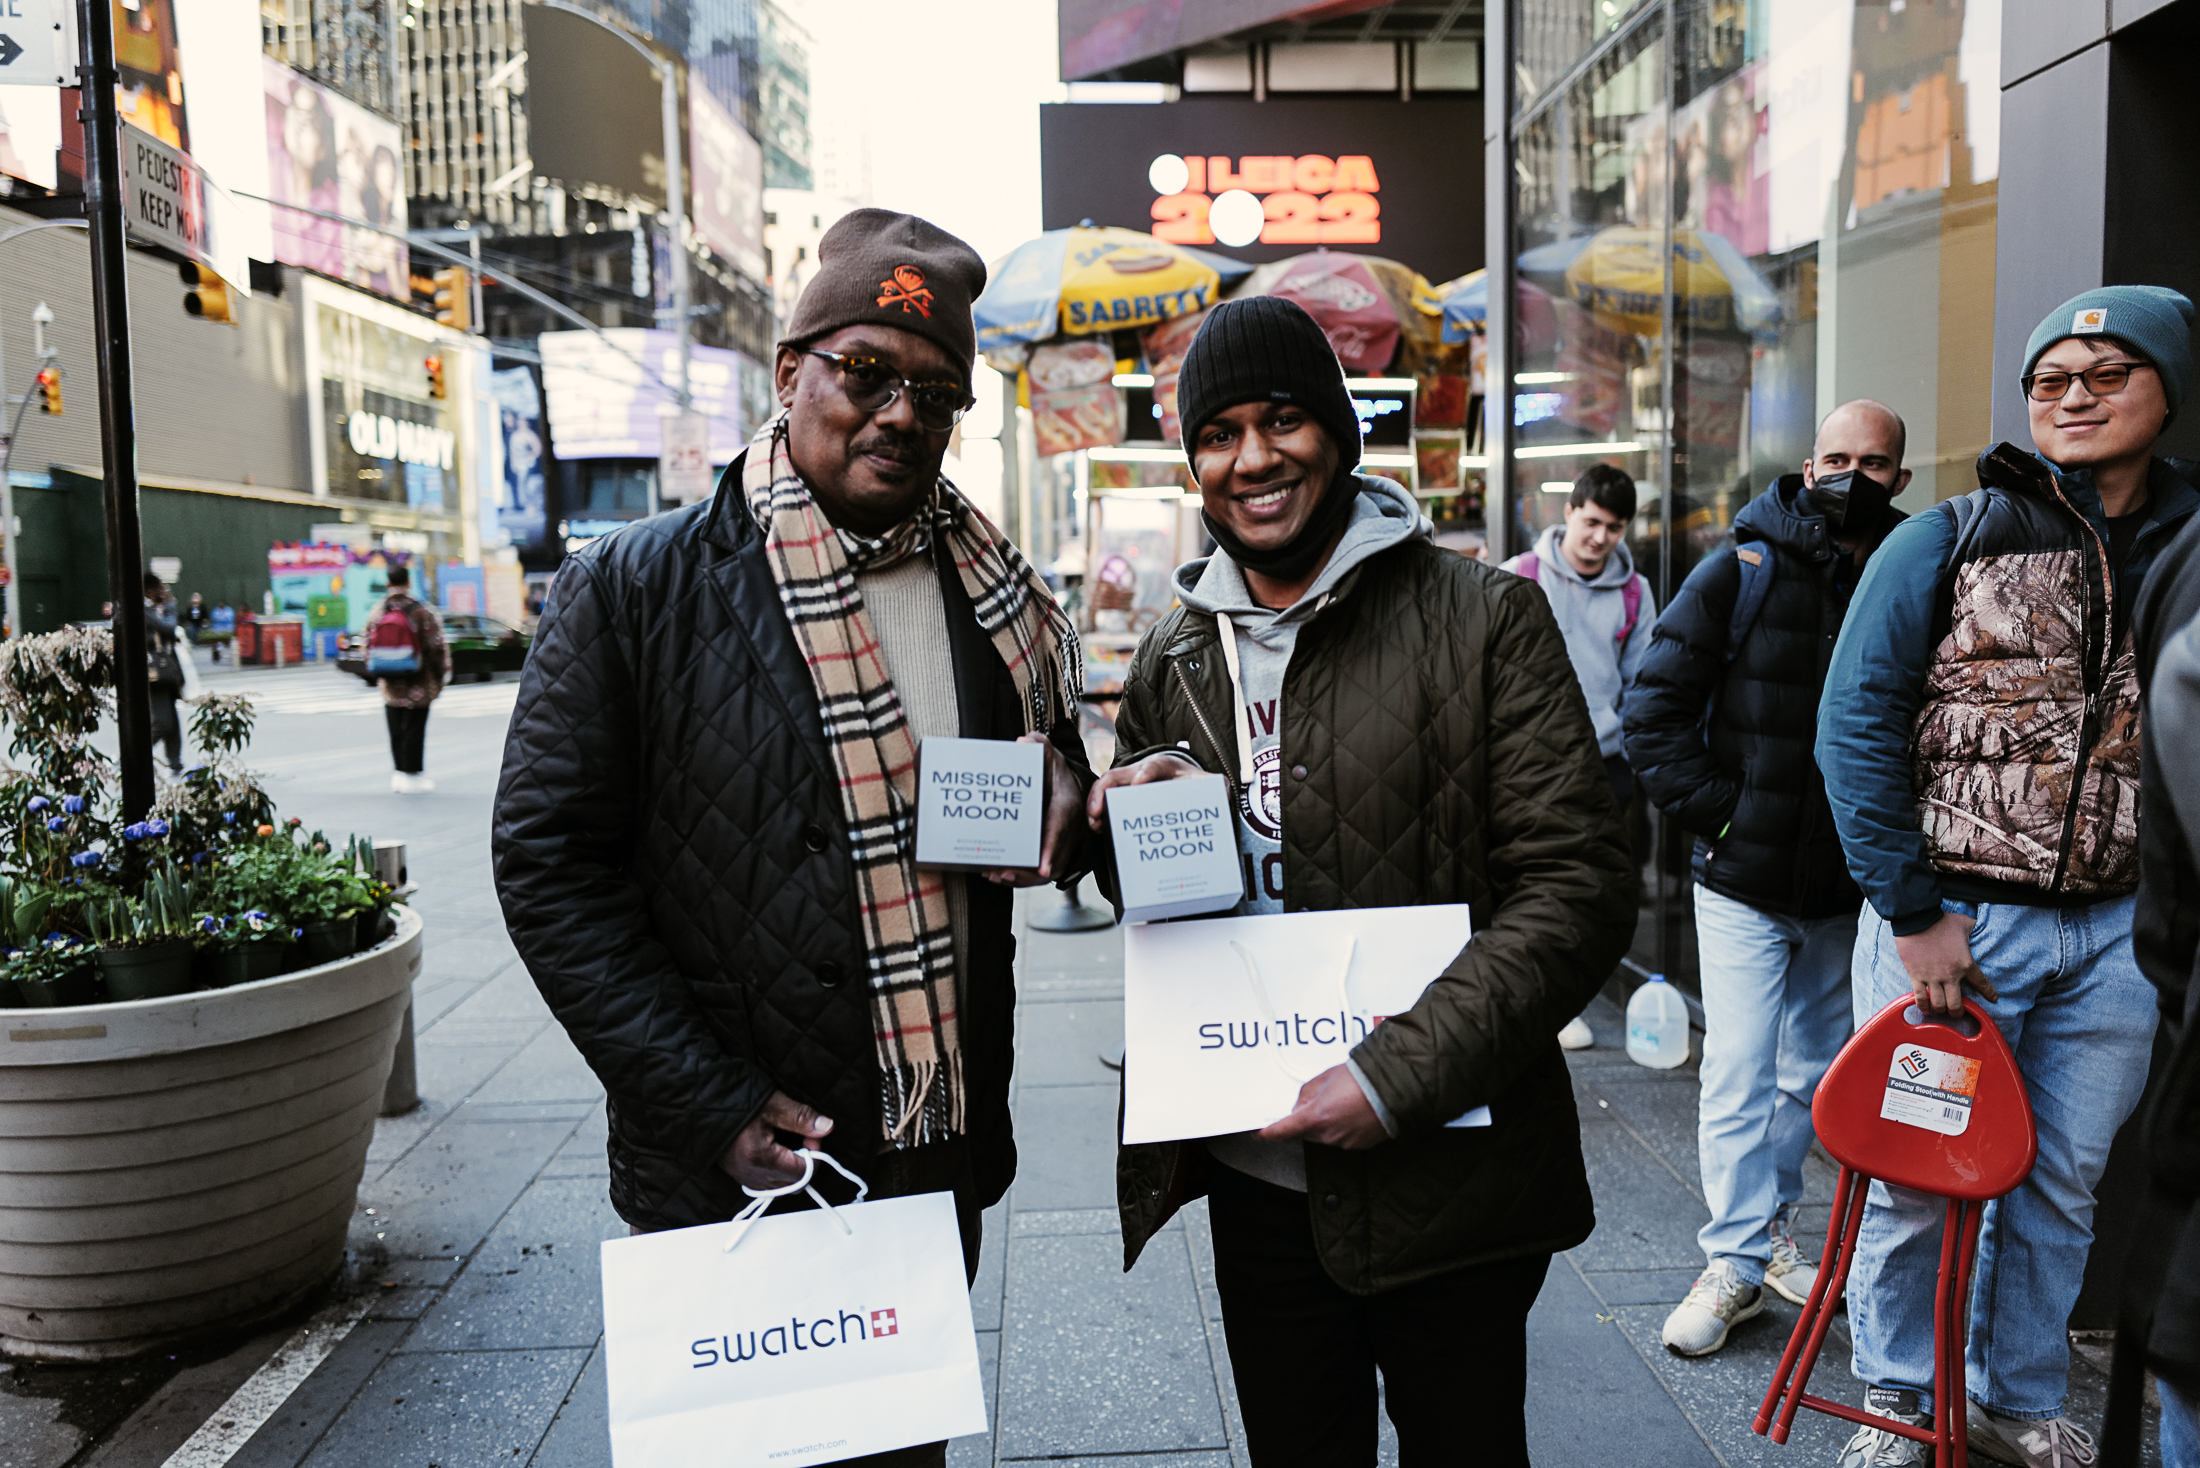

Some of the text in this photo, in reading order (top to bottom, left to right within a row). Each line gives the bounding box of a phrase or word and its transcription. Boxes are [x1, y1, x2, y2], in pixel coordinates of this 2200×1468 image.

[139, 187, 173, 231] KEEP
[1070, 286, 1208, 326] SABRETT
[349, 409, 396, 460] OLD
[932, 771, 1032, 788] MISSION
[940, 787, 1022, 804] TO THE
[943, 805, 1018, 820] MOON
[1122, 806, 1219, 831] MISSION
[1133, 823, 1214, 845] TO THE
[1140, 840, 1213, 861] MOON
[1199, 1011, 1367, 1049] swatch
[1890, 1080, 1914, 1091] Folding
[1915, 1086, 1932, 1095] Stool
[1932, 1090, 1946, 1099] with
[1946, 1094, 1969, 1105] Handle
[691, 1309, 866, 1368] swatch
[768, 1439, 847, 1460] www.swatch.com
[2017, 1430, 2051, 1455] N
